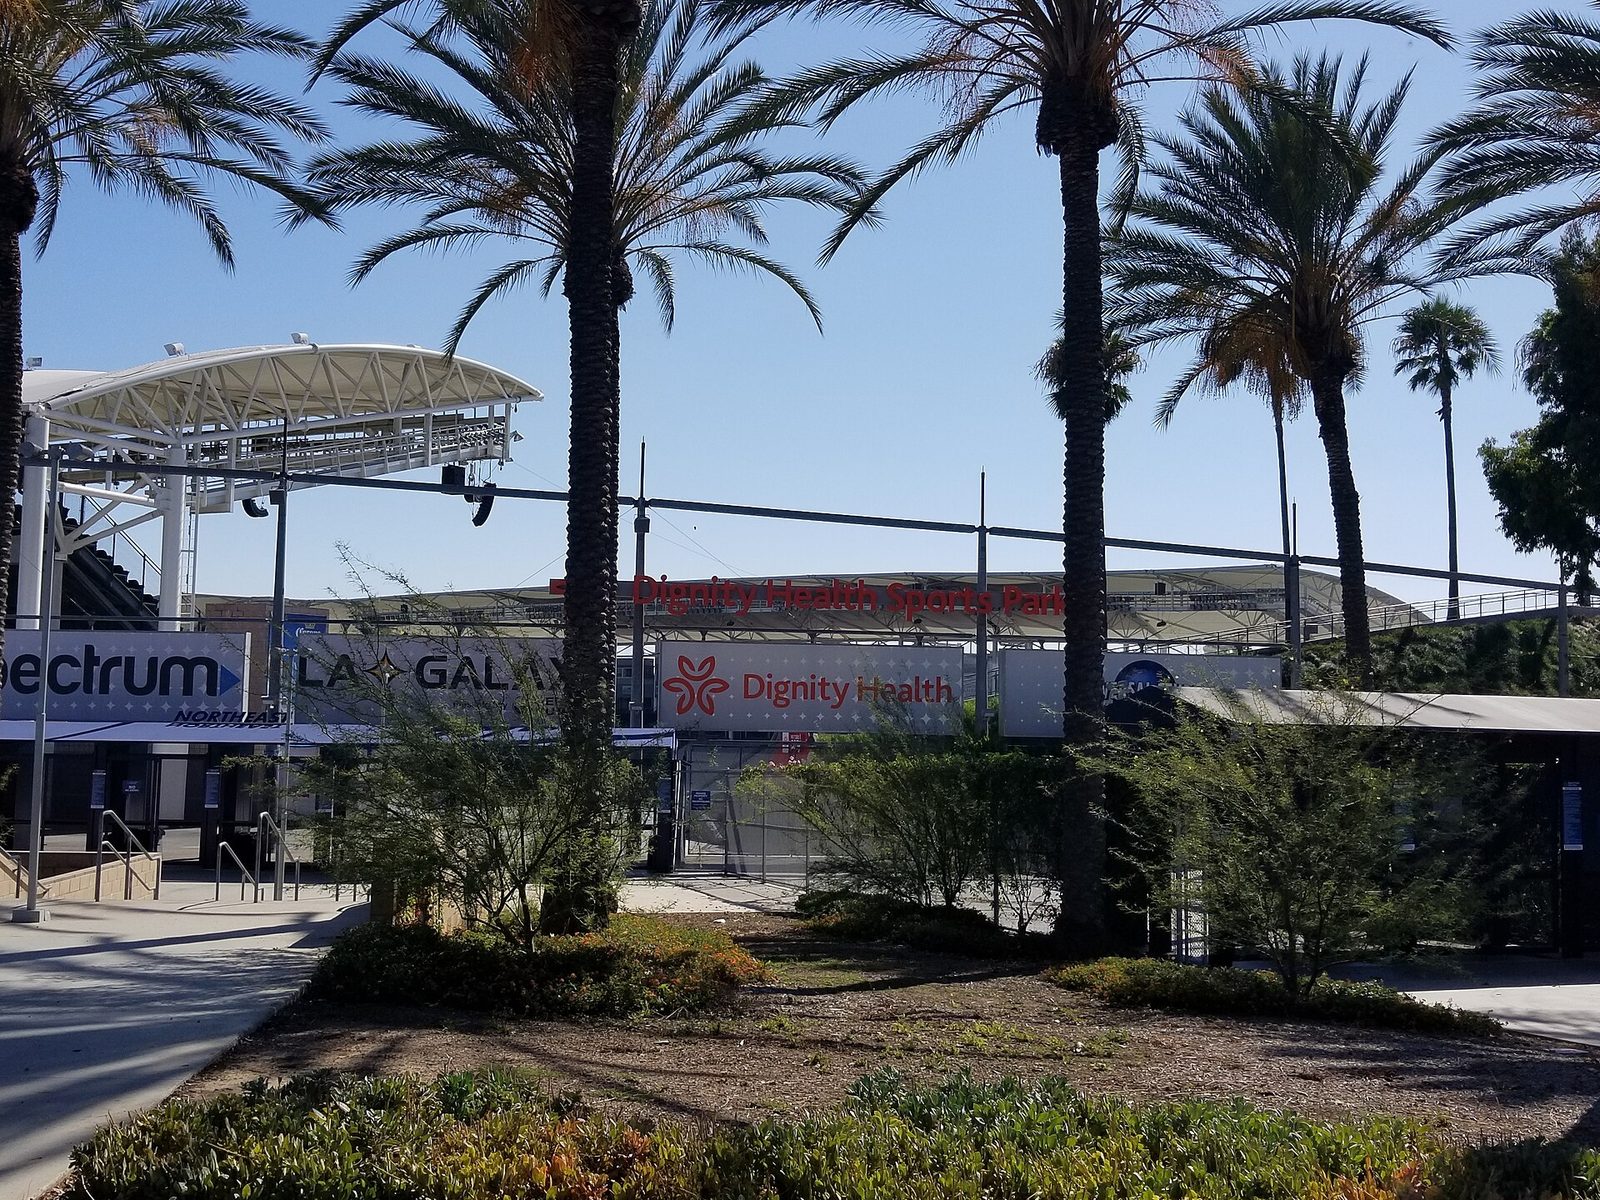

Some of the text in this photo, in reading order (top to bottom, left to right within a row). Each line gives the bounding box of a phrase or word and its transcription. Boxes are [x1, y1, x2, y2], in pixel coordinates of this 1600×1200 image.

[633, 574, 1065, 621] Dignity Health Sports Park
[0, 644, 219, 697] ectrum
[299, 654, 361, 689] LA
[743, 673, 953, 709] Dignity Health
